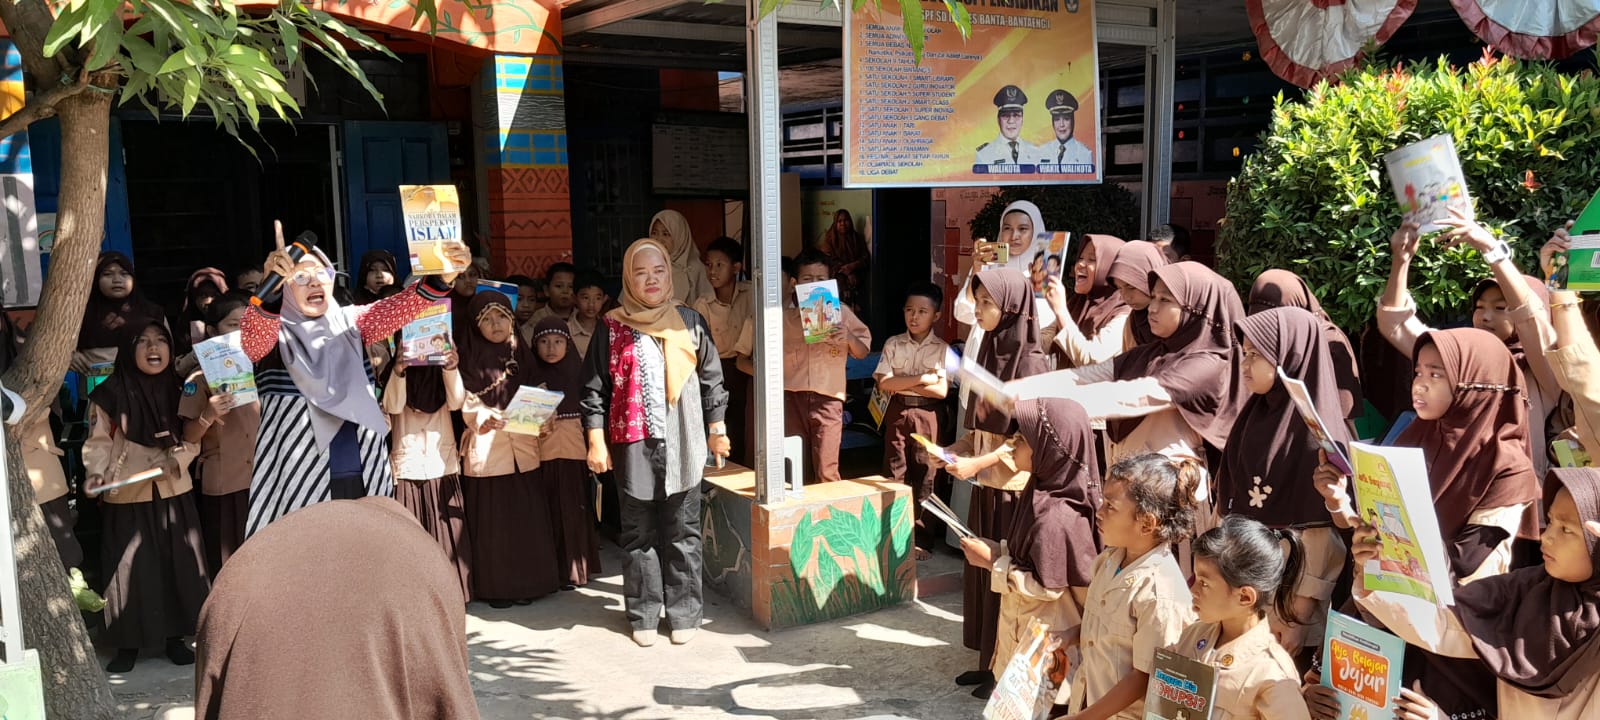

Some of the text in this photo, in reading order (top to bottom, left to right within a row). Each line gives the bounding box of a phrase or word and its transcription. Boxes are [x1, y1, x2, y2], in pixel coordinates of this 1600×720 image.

[937, 10, 946, 22] SD
[988, 164, 1020, 174] WALIKOTA
[1040, 164, 1092, 174] WAKIL WALIKOTA
[409, 219, 457, 228] PERSPEKTIF
[410, 226, 457, 242] ISLAM
[1353, 648, 1387, 674] Belajar
[1339, 657, 1385, 692] Jujur
